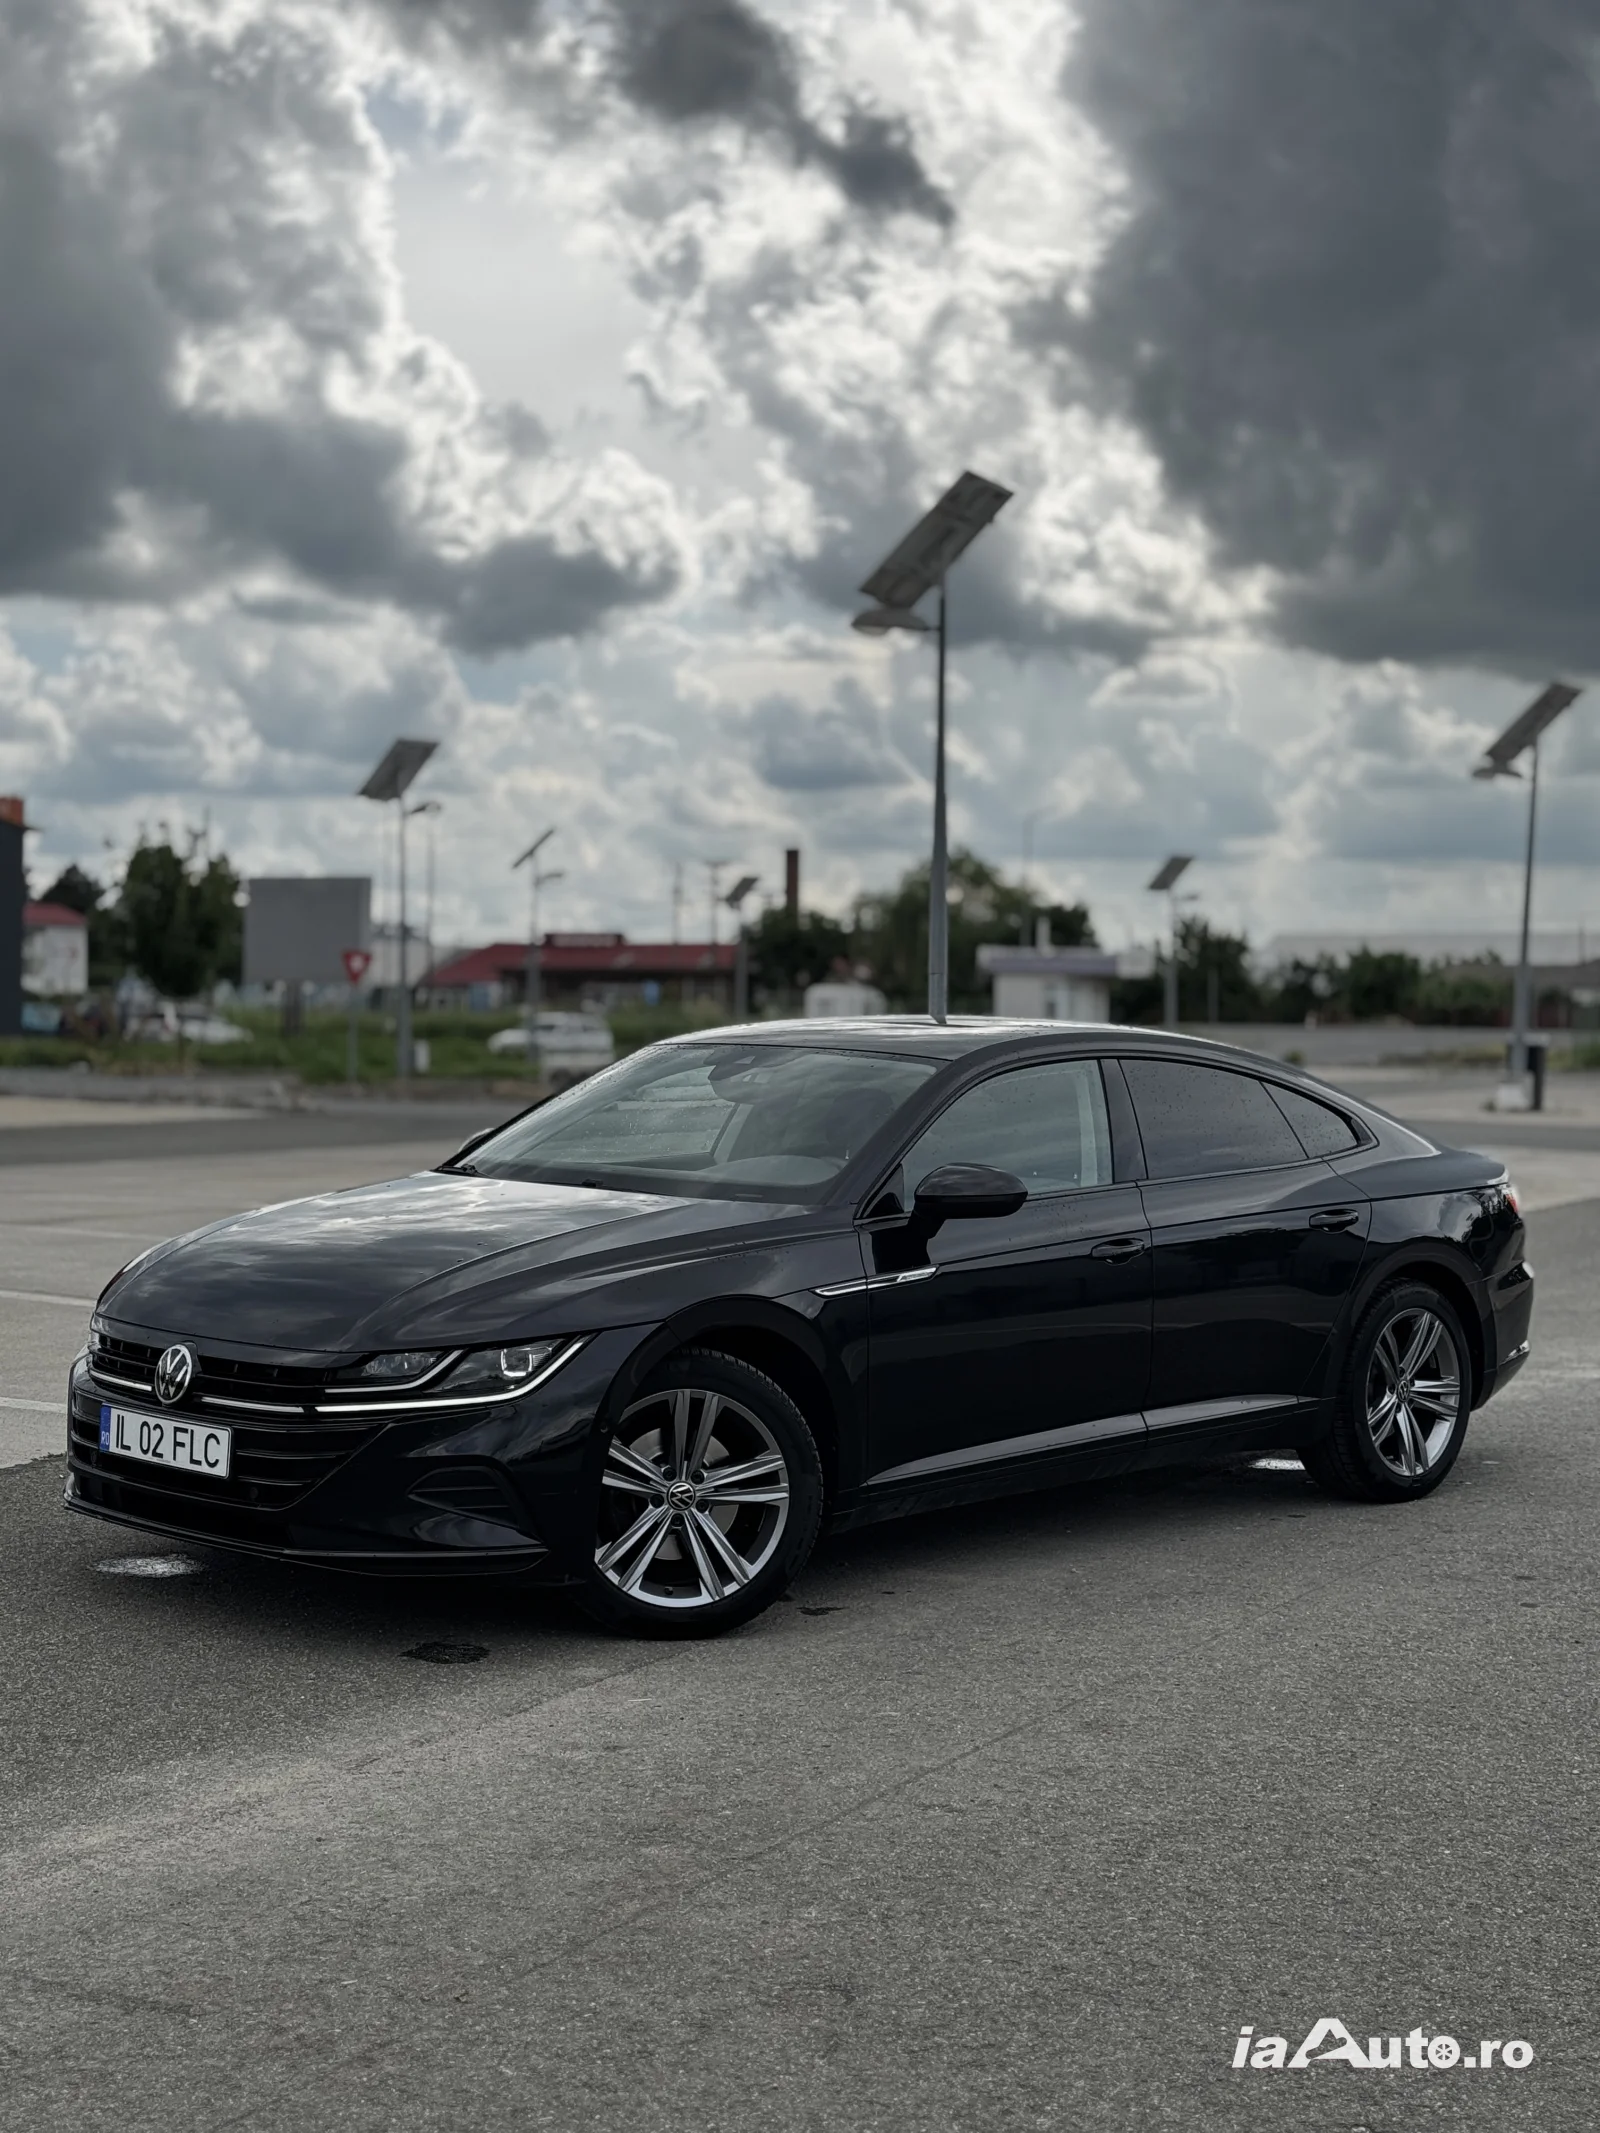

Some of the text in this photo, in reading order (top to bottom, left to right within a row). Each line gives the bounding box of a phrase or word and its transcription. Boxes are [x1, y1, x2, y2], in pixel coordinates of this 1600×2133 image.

[101, 1431, 110, 1446] RO
[116, 1414, 220, 1468] IL 02 FLC
